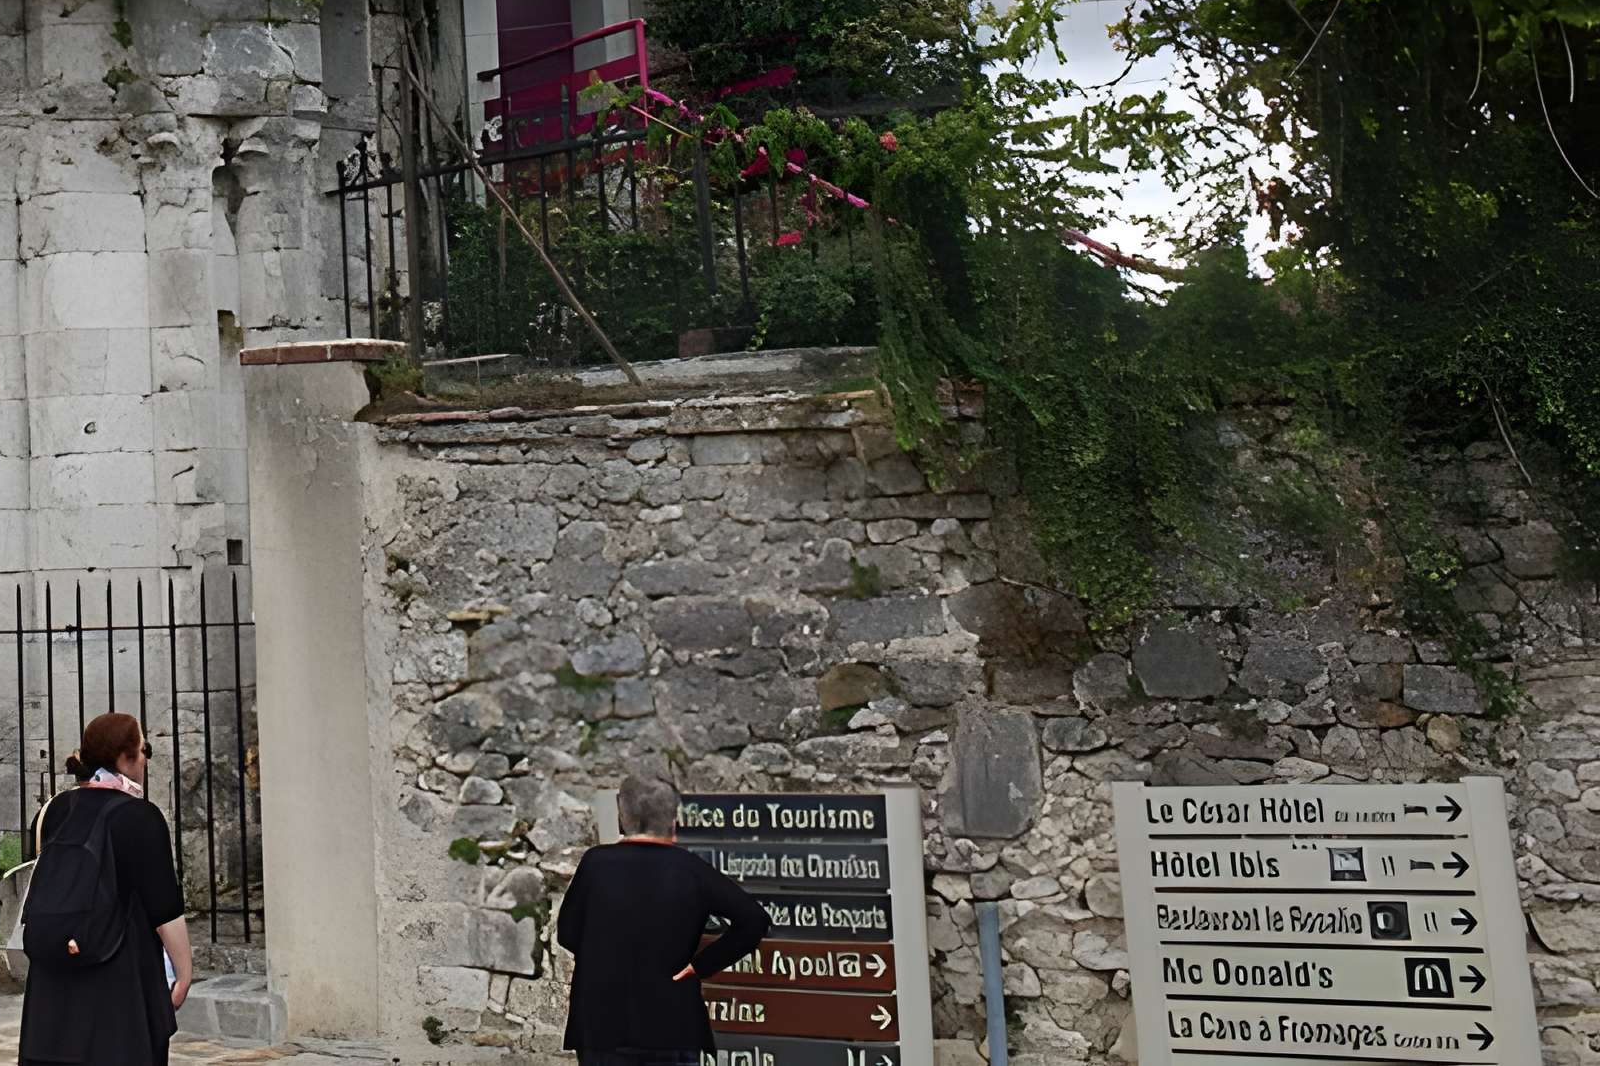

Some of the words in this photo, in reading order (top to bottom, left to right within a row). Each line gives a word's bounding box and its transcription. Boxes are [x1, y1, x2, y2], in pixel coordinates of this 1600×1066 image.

[766, 803, 875, 830] Tourisme
[1146, 798, 1173, 823] Le
[1213, 958, 1333, 988] Donald's
[1168, 1011, 1192, 1038] La
